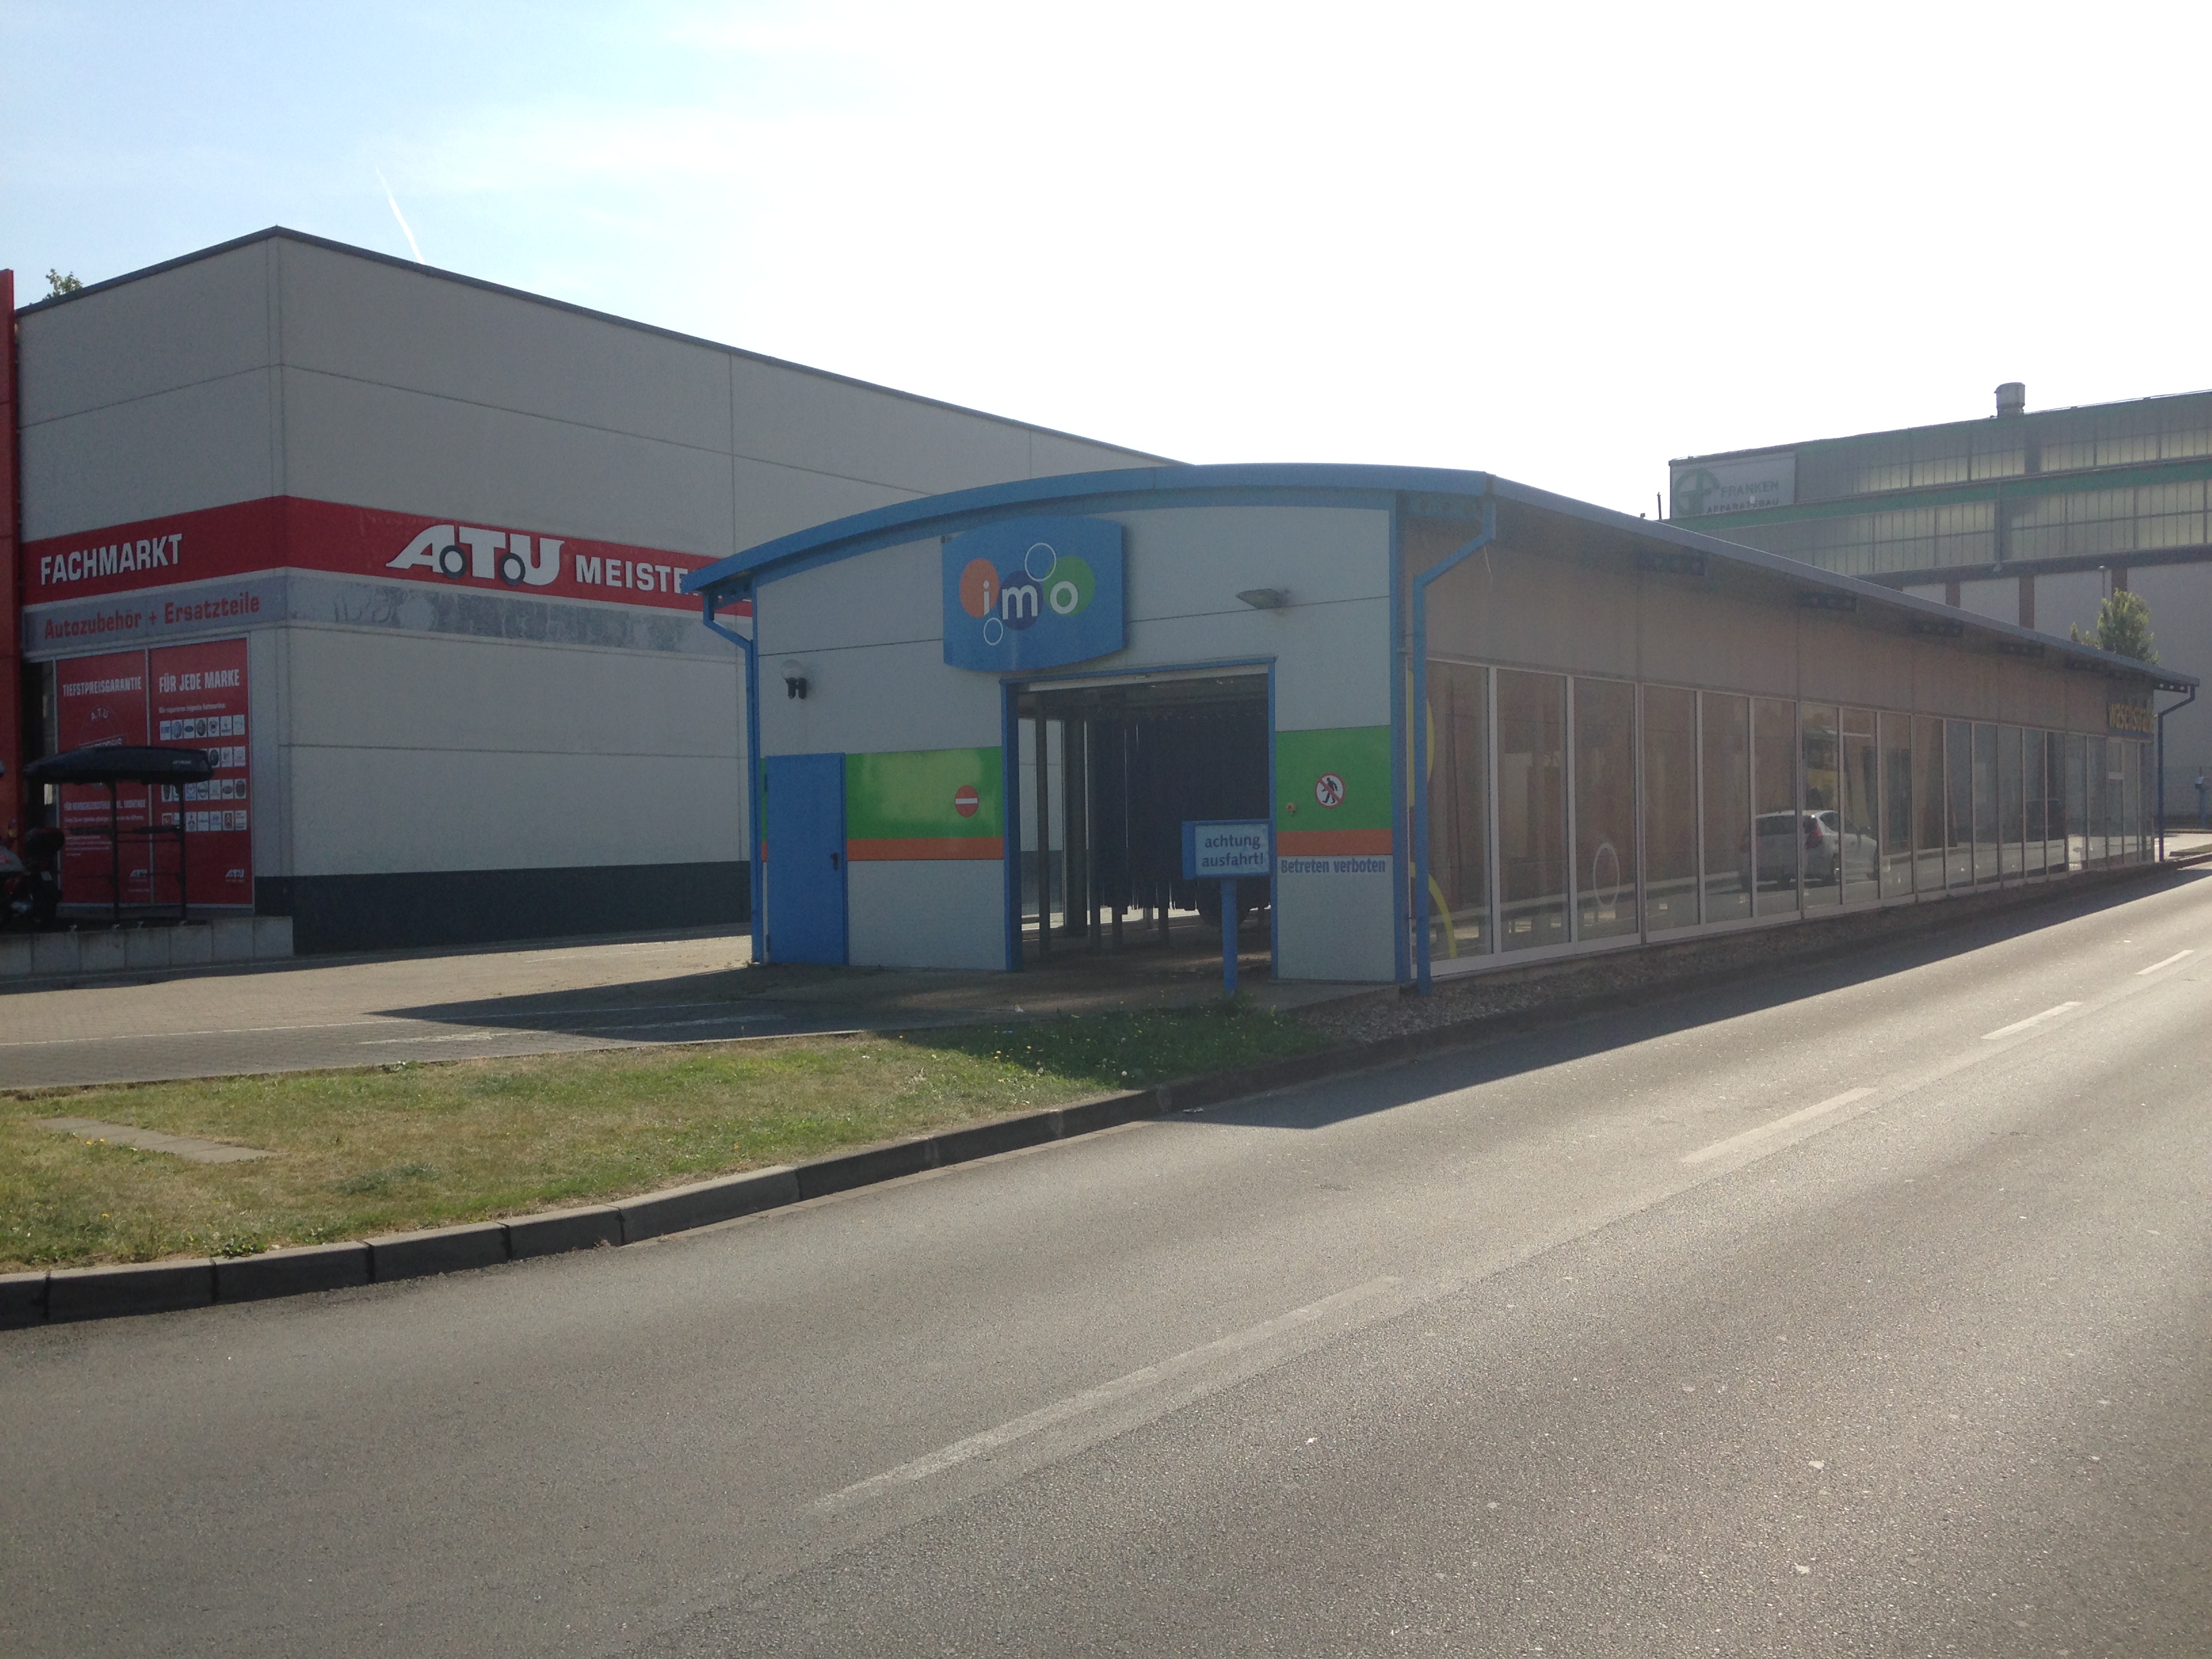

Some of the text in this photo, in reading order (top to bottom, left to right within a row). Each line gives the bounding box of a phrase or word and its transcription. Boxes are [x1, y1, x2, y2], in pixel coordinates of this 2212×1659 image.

[1721, 480, 1779, 497] FRANKEN
[41, 533, 183, 585] FACHMARKT
[385, 524, 698, 596] ATU MEISTE
[982, 579, 1079, 619] imo
[45, 592, 260, 639] Autozubehör + Ersatzteile
[62, 676, 142, 697] TIEFSTPREISGARANTIE
[159, 669, 240, 693] FÜR JEDE MARKE
[1204, 834, 1261, 850] achtung
[1202, 853, 1264, 867] ausfahrt!
[1281, 857, 1386, 874] Betreten verboten
